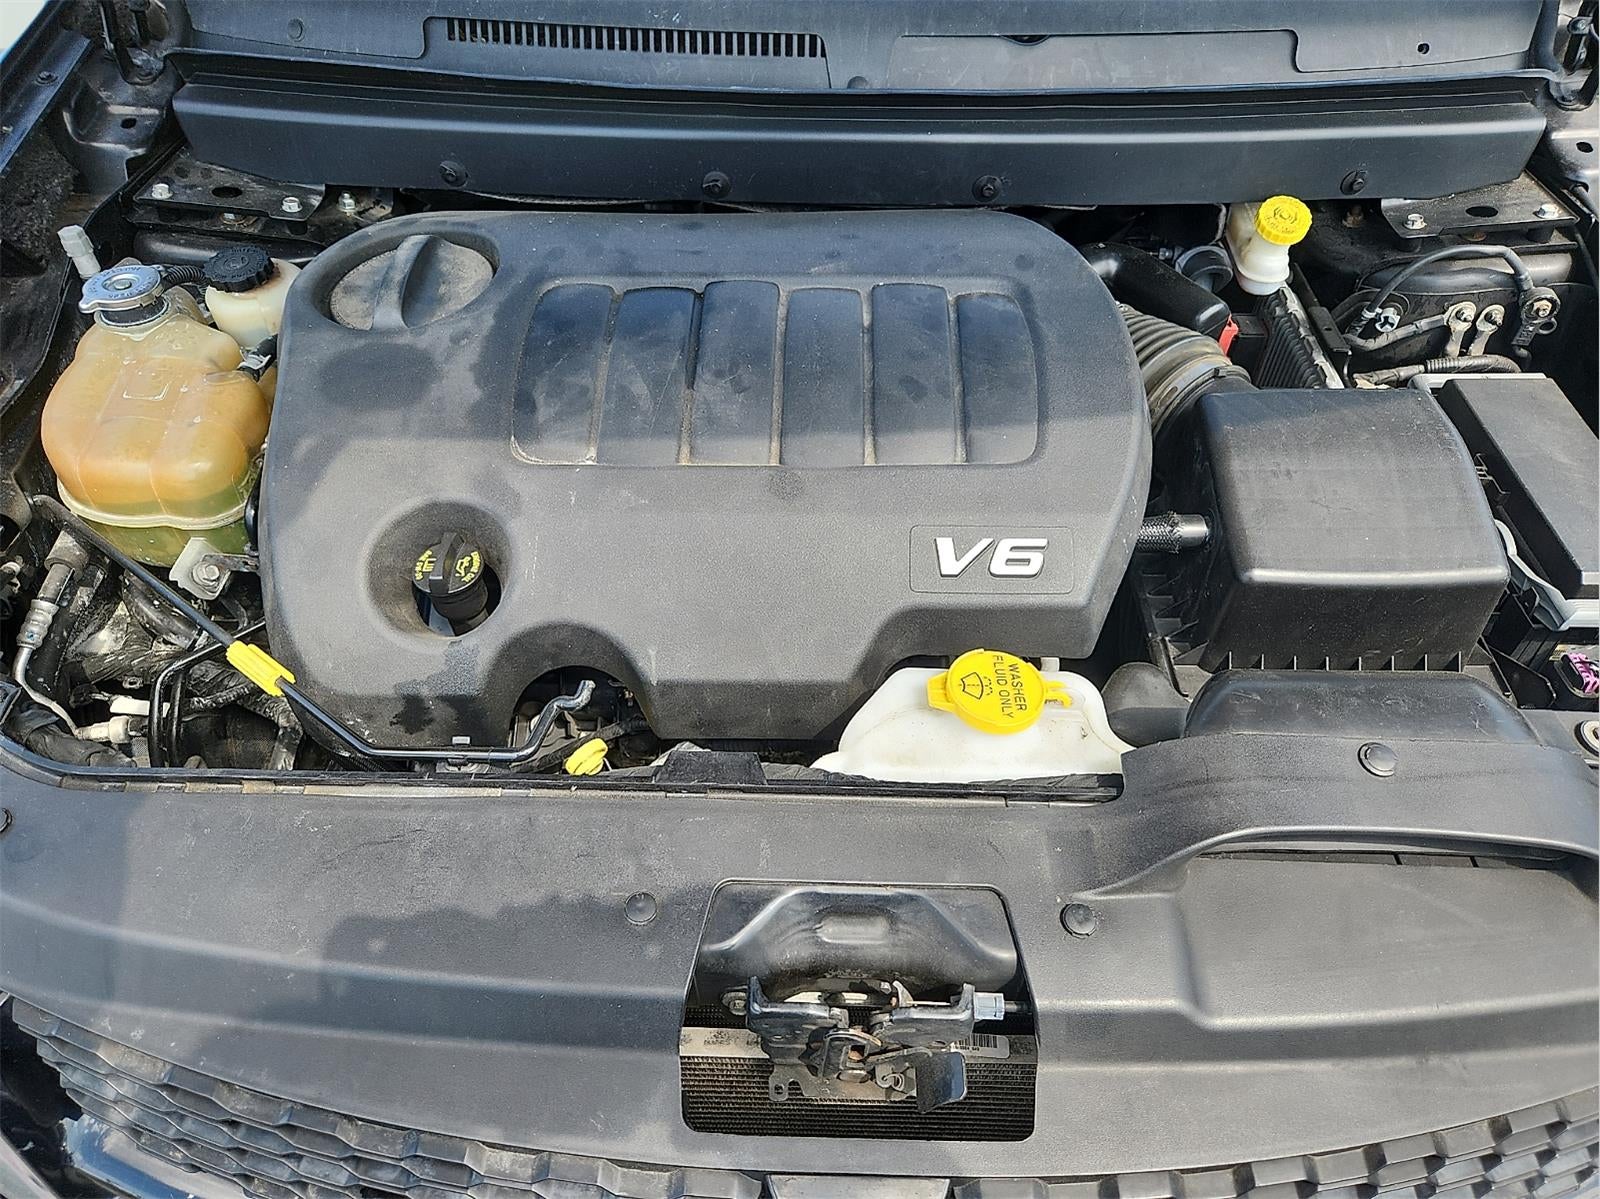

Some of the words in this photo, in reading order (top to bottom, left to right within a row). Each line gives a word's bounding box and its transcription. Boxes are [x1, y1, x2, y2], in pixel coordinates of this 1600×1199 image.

[934, 537, 1048, 578] V6
[992, 655, 1008, 686] FLUID
[1008, 663, 1028, 711] WASHER
[998, 689, 1015, 719] ONLY
